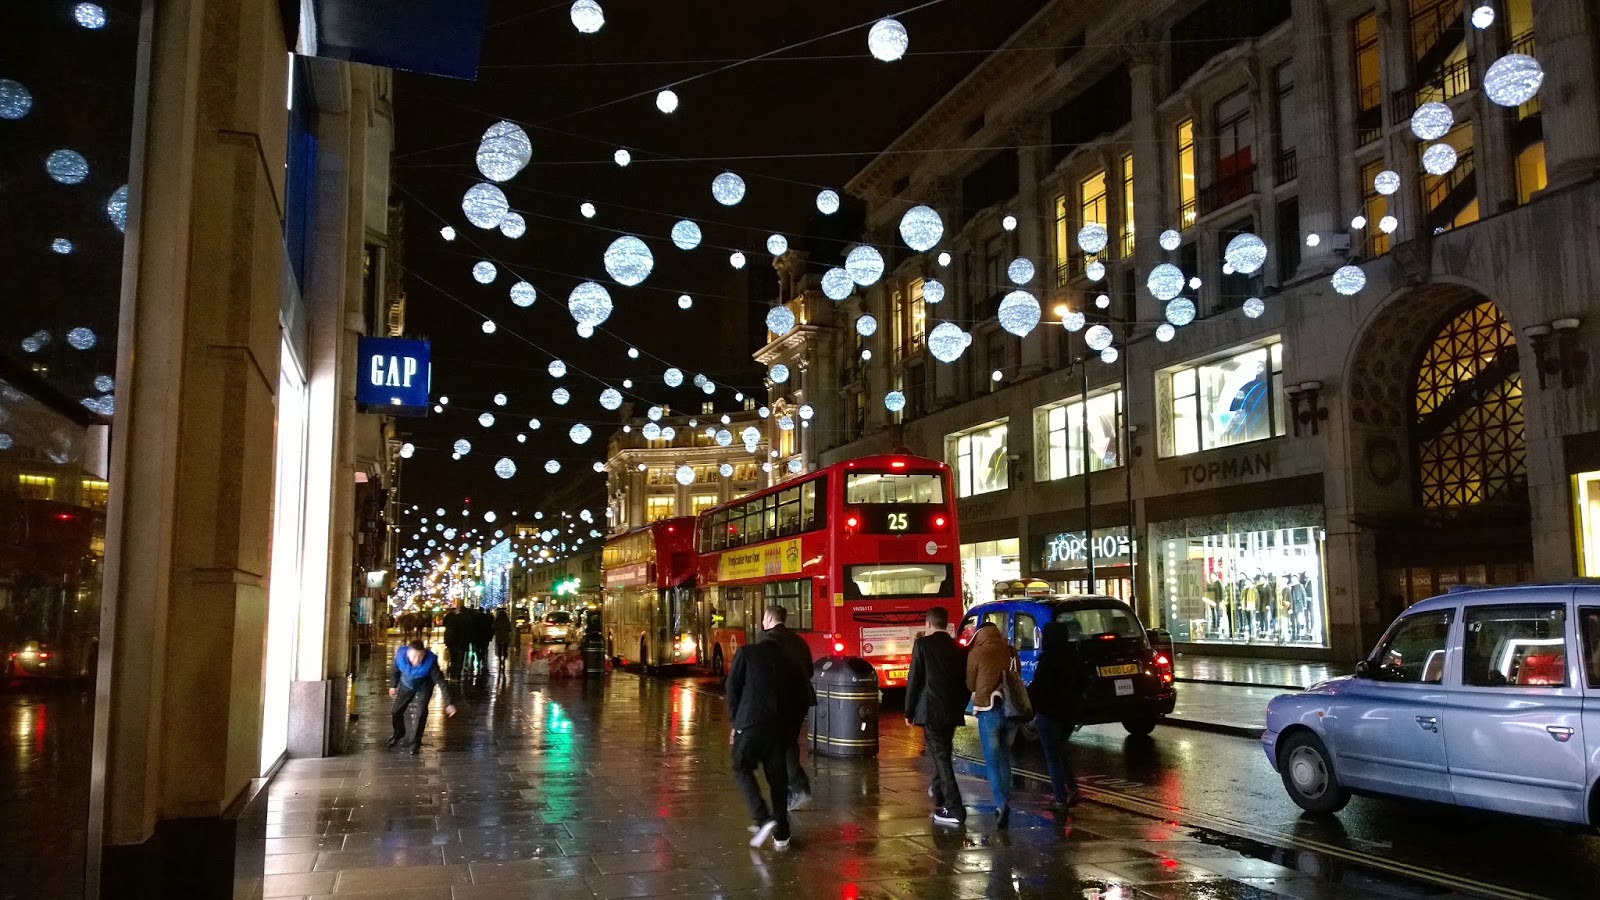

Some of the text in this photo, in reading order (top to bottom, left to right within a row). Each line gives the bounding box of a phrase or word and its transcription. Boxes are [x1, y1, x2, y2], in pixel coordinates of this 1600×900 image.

[371, 354, 417, 387] GAP
[1180, 451, 1271, 485] TOPMAN
[887, 513, 908, 530] 25
